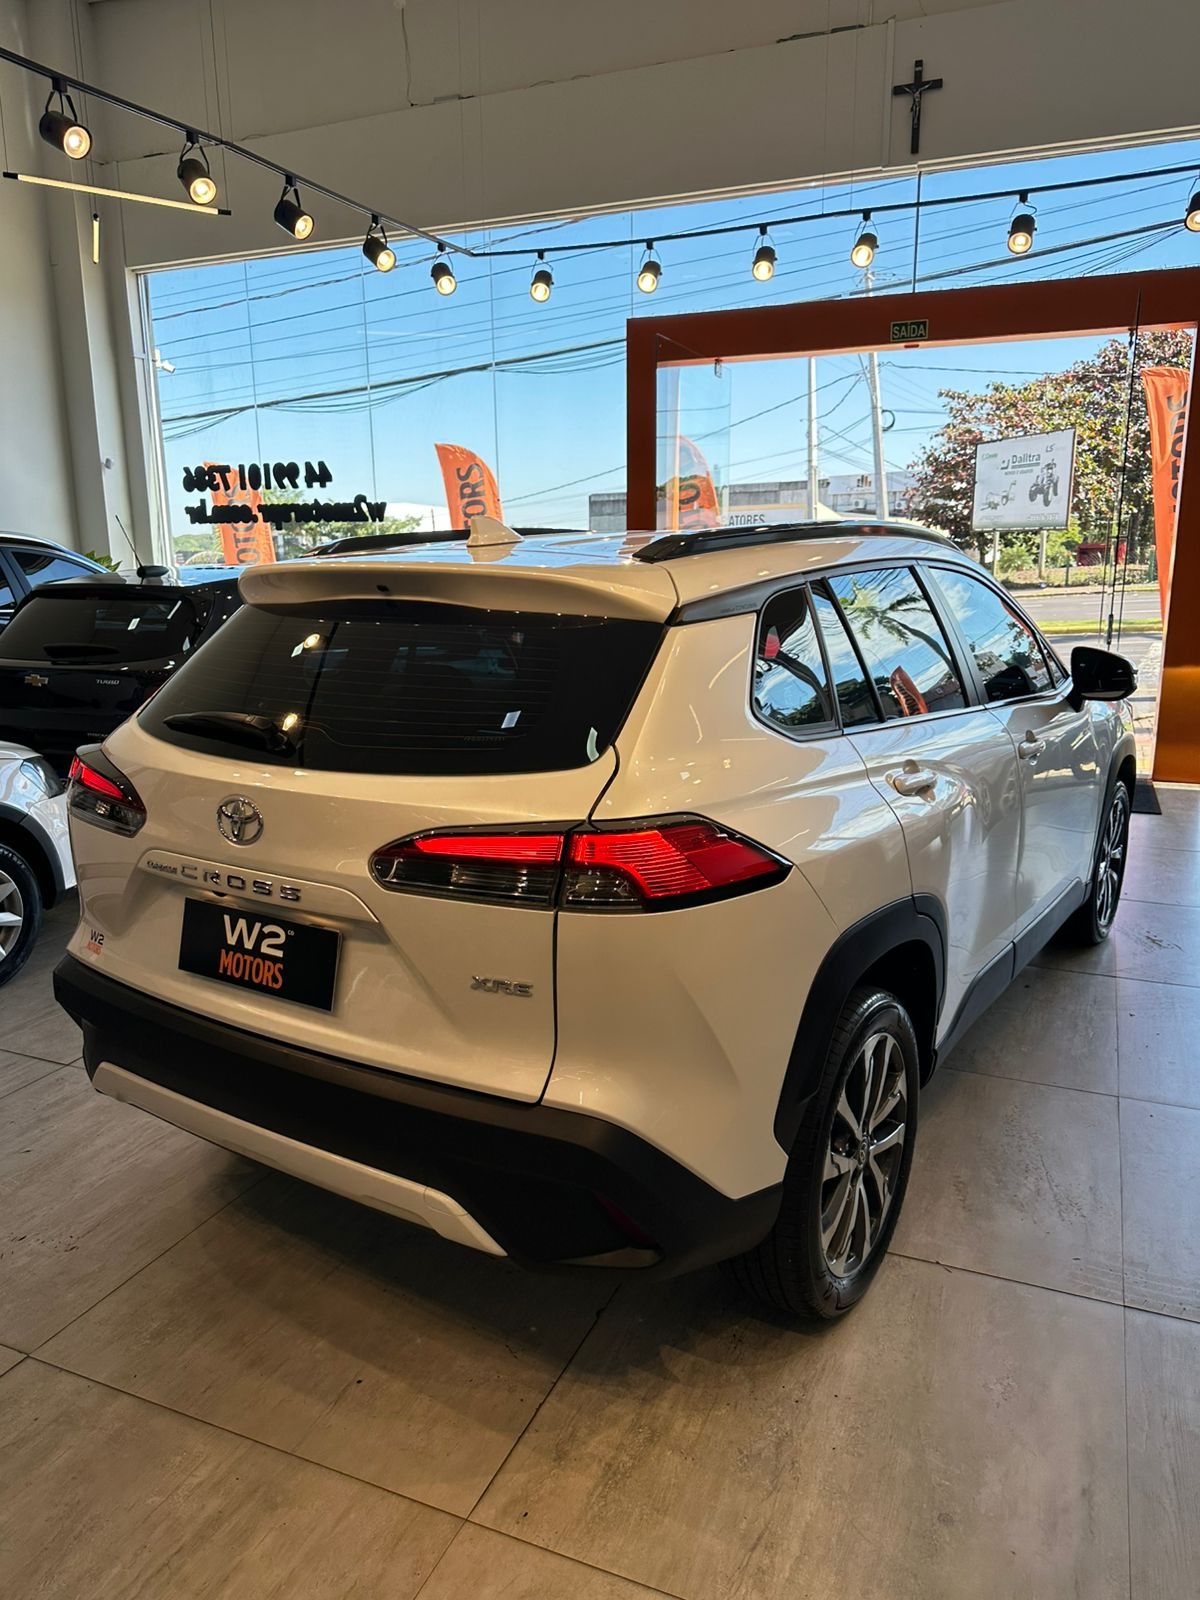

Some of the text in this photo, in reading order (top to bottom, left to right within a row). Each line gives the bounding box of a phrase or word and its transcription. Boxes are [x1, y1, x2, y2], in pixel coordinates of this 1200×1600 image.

[893, 321, 926, 338] SAÍDA
[1011, 453, 1041, 464] Dalitra
[456, 463, 486, 529] ORS
[180, 862, 301, 902] CROSS
[90, 929, 105, 946] W2
[223, 914, 286, 958] W2
[219, 948, 284, 989] MOTORS
